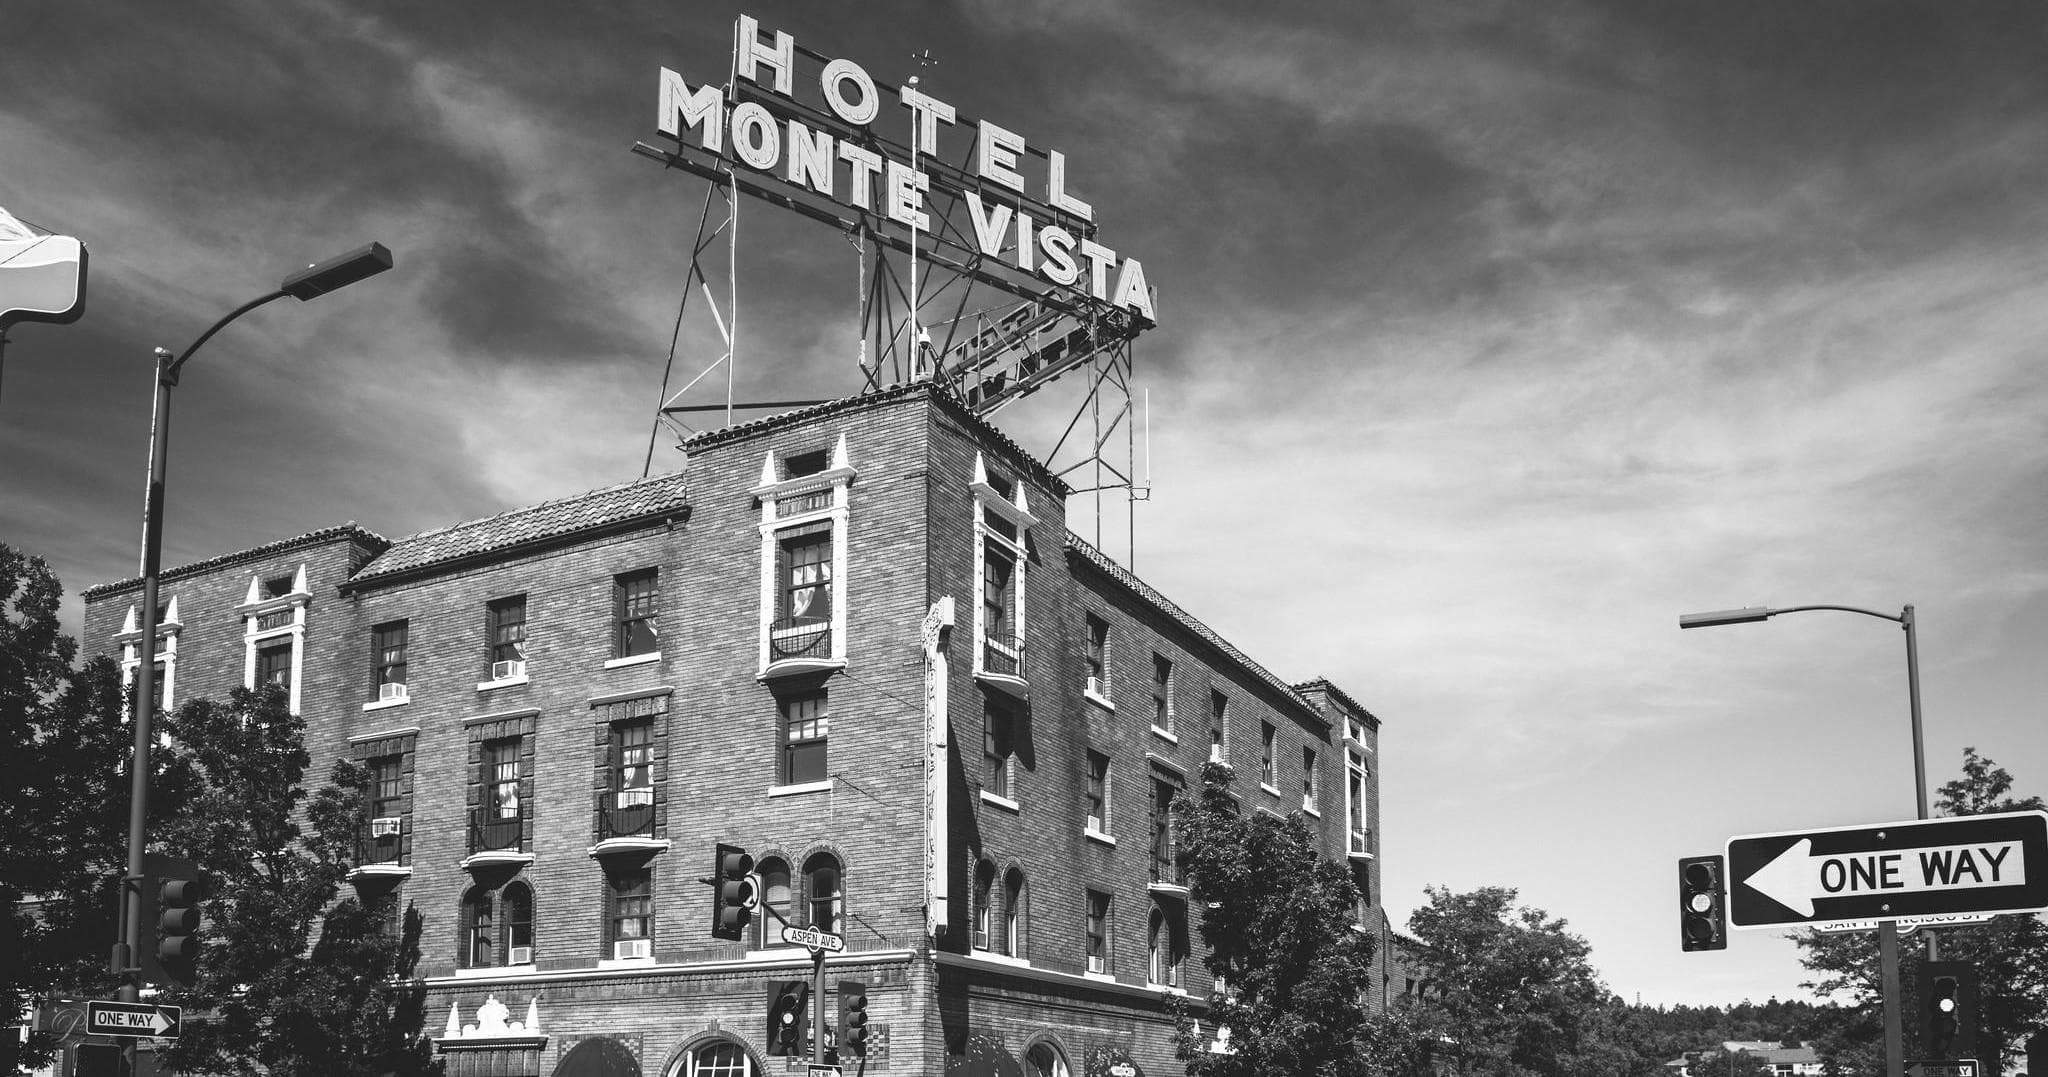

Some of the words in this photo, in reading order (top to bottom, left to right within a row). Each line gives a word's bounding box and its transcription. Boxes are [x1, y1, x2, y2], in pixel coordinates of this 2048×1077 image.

[738, 13, 1092, 222] HOTEL
[657, 66, 930, 232] MONTE
[964, 189, 1156, 324] VISTA
[1820, 854, 1904, 893] ONE
[1919, 846, 2011, 886] WAY
[792, 930, 818, 945] ASPEN
[821, 935, 836, 948] AVE
[98, 1012, 124, 1025] ONE
[128, 1013, 153, 1027] WAY
[1923, 1067, 1944, 1076] ONE
[1947, 1067, 1969, 1076] WAY
